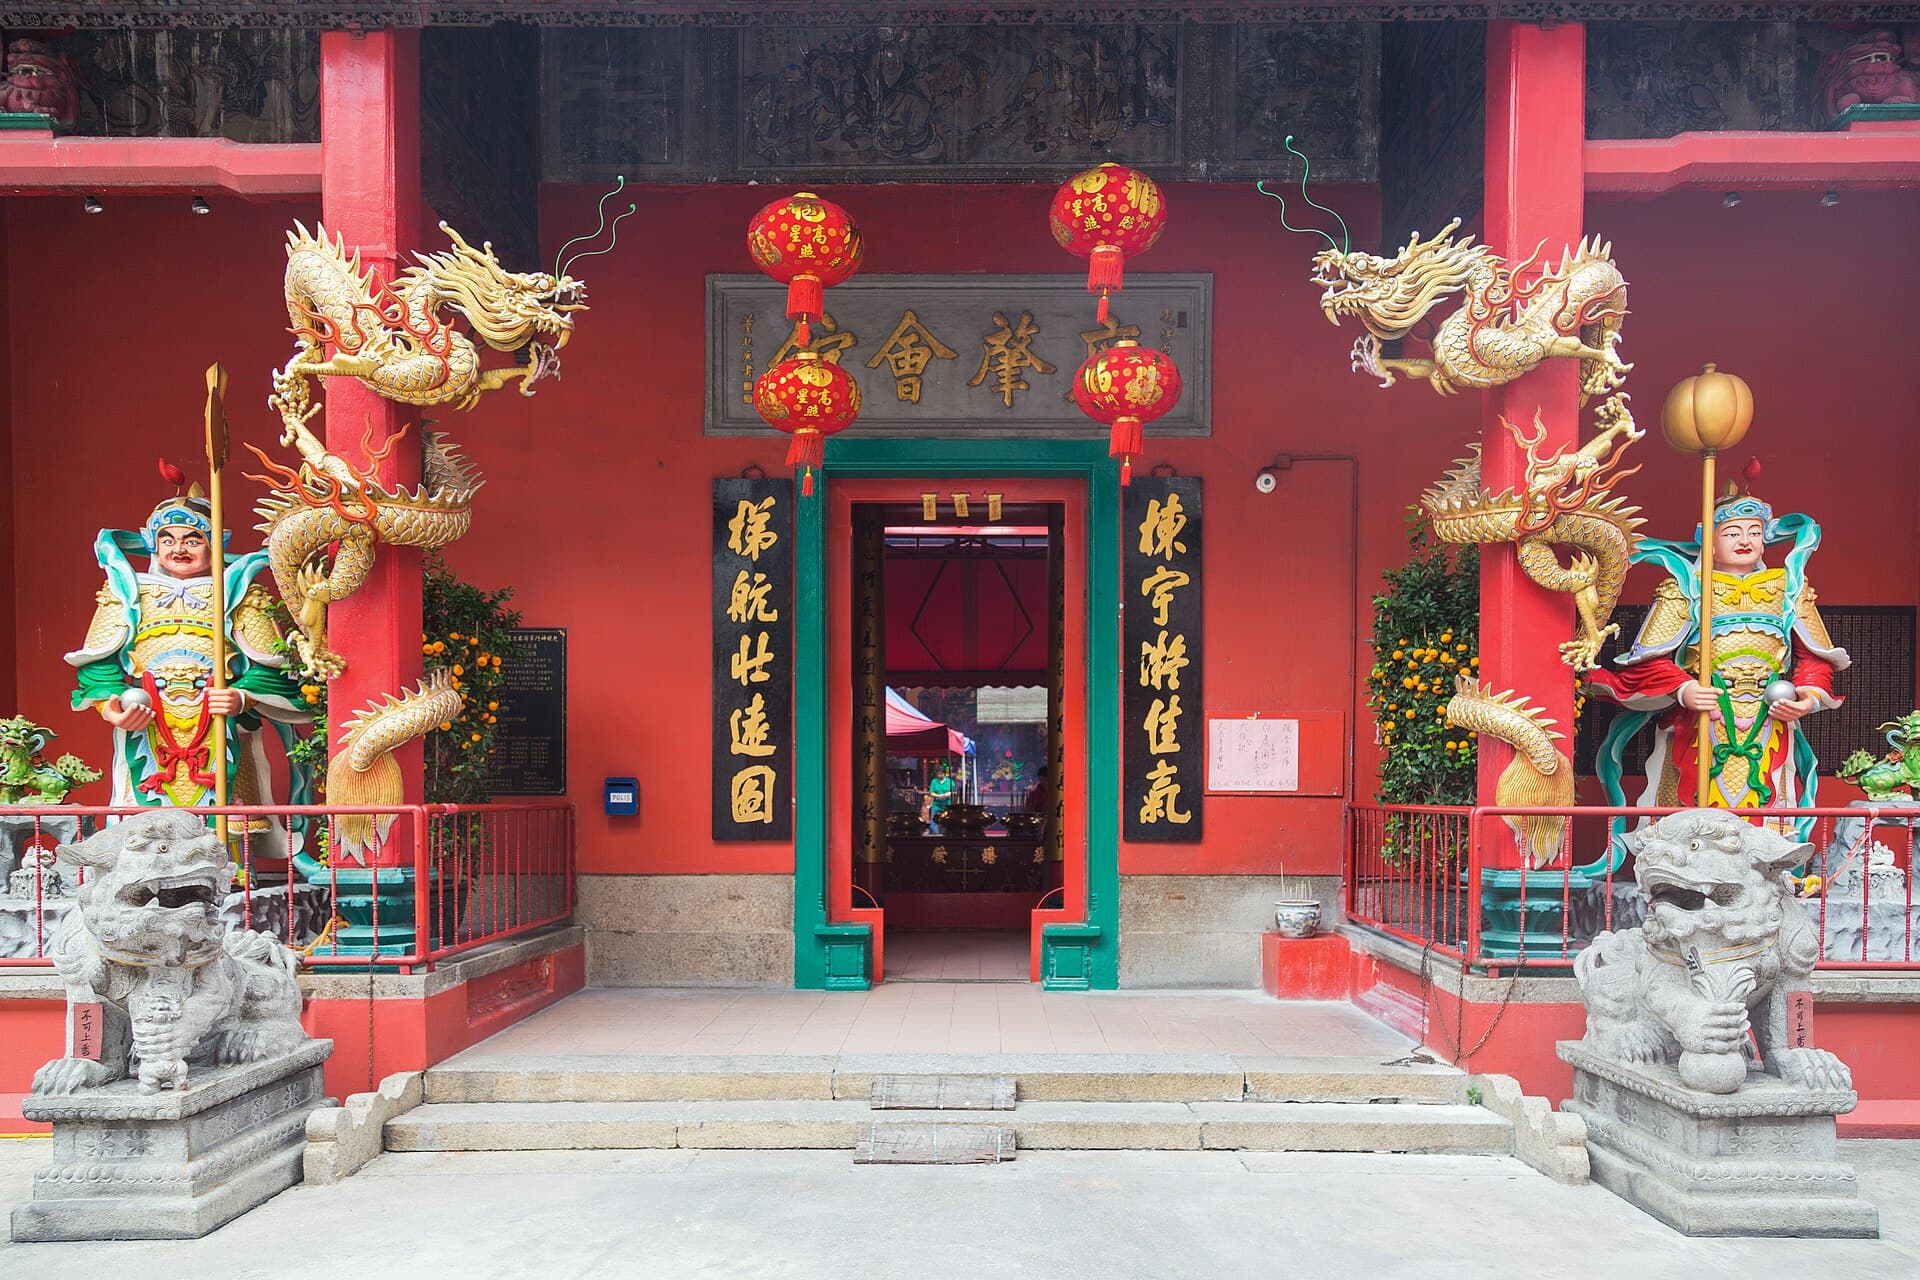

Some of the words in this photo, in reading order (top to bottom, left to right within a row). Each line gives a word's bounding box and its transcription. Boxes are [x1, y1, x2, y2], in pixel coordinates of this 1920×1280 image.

[768, 310, 1140, 408] 肇會
[81, 1009, 91, 1056] 不可上香
[1795, 998, 1805, 1047] 不可上香
